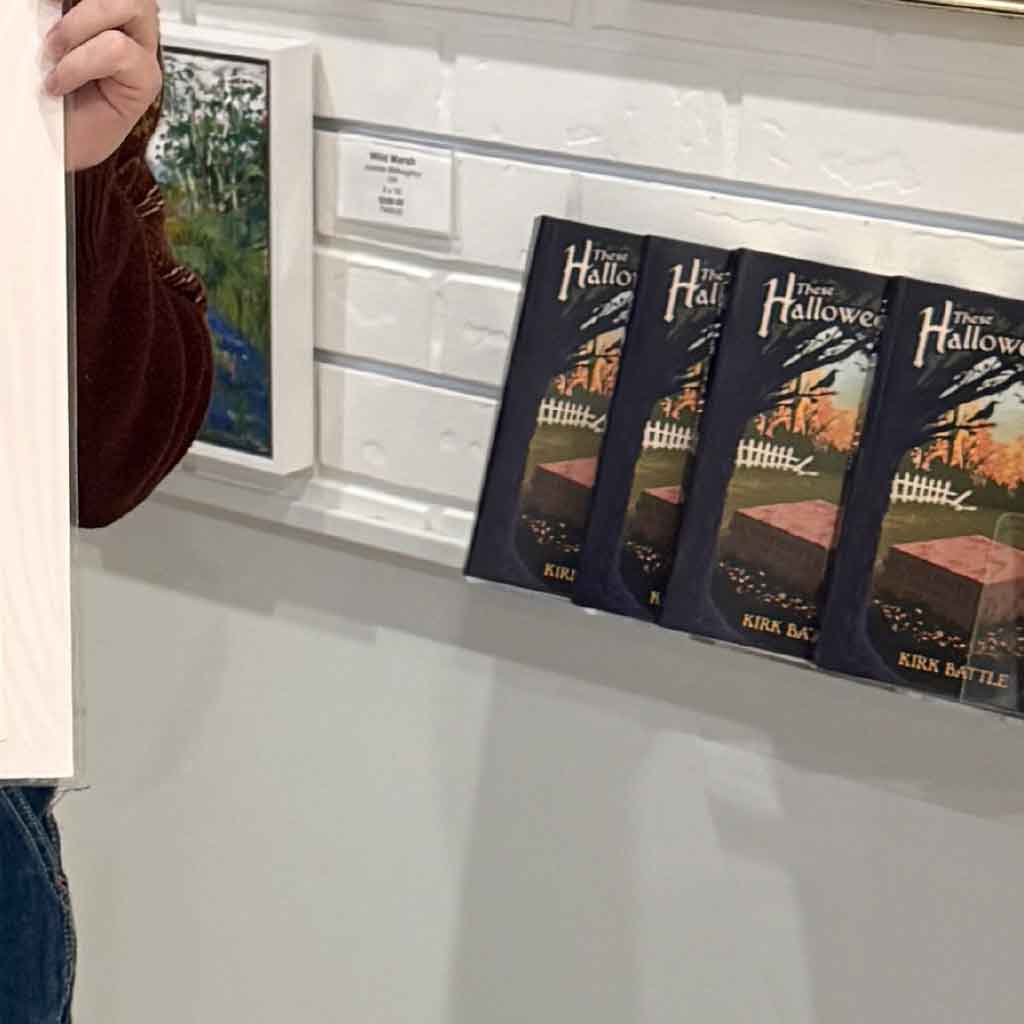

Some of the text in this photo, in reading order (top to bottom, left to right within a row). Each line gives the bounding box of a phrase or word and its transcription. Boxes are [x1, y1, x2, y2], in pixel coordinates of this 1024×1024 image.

[592, 248, 629, 262] These
[557, 239, 637, 302] Hallo
[796, 281, 835, 296] These
[952, 309, 994, 325] These
[741, 613, 782, 635] KIRK
[897, 651, 1010, 689] KIRK BATTLE
